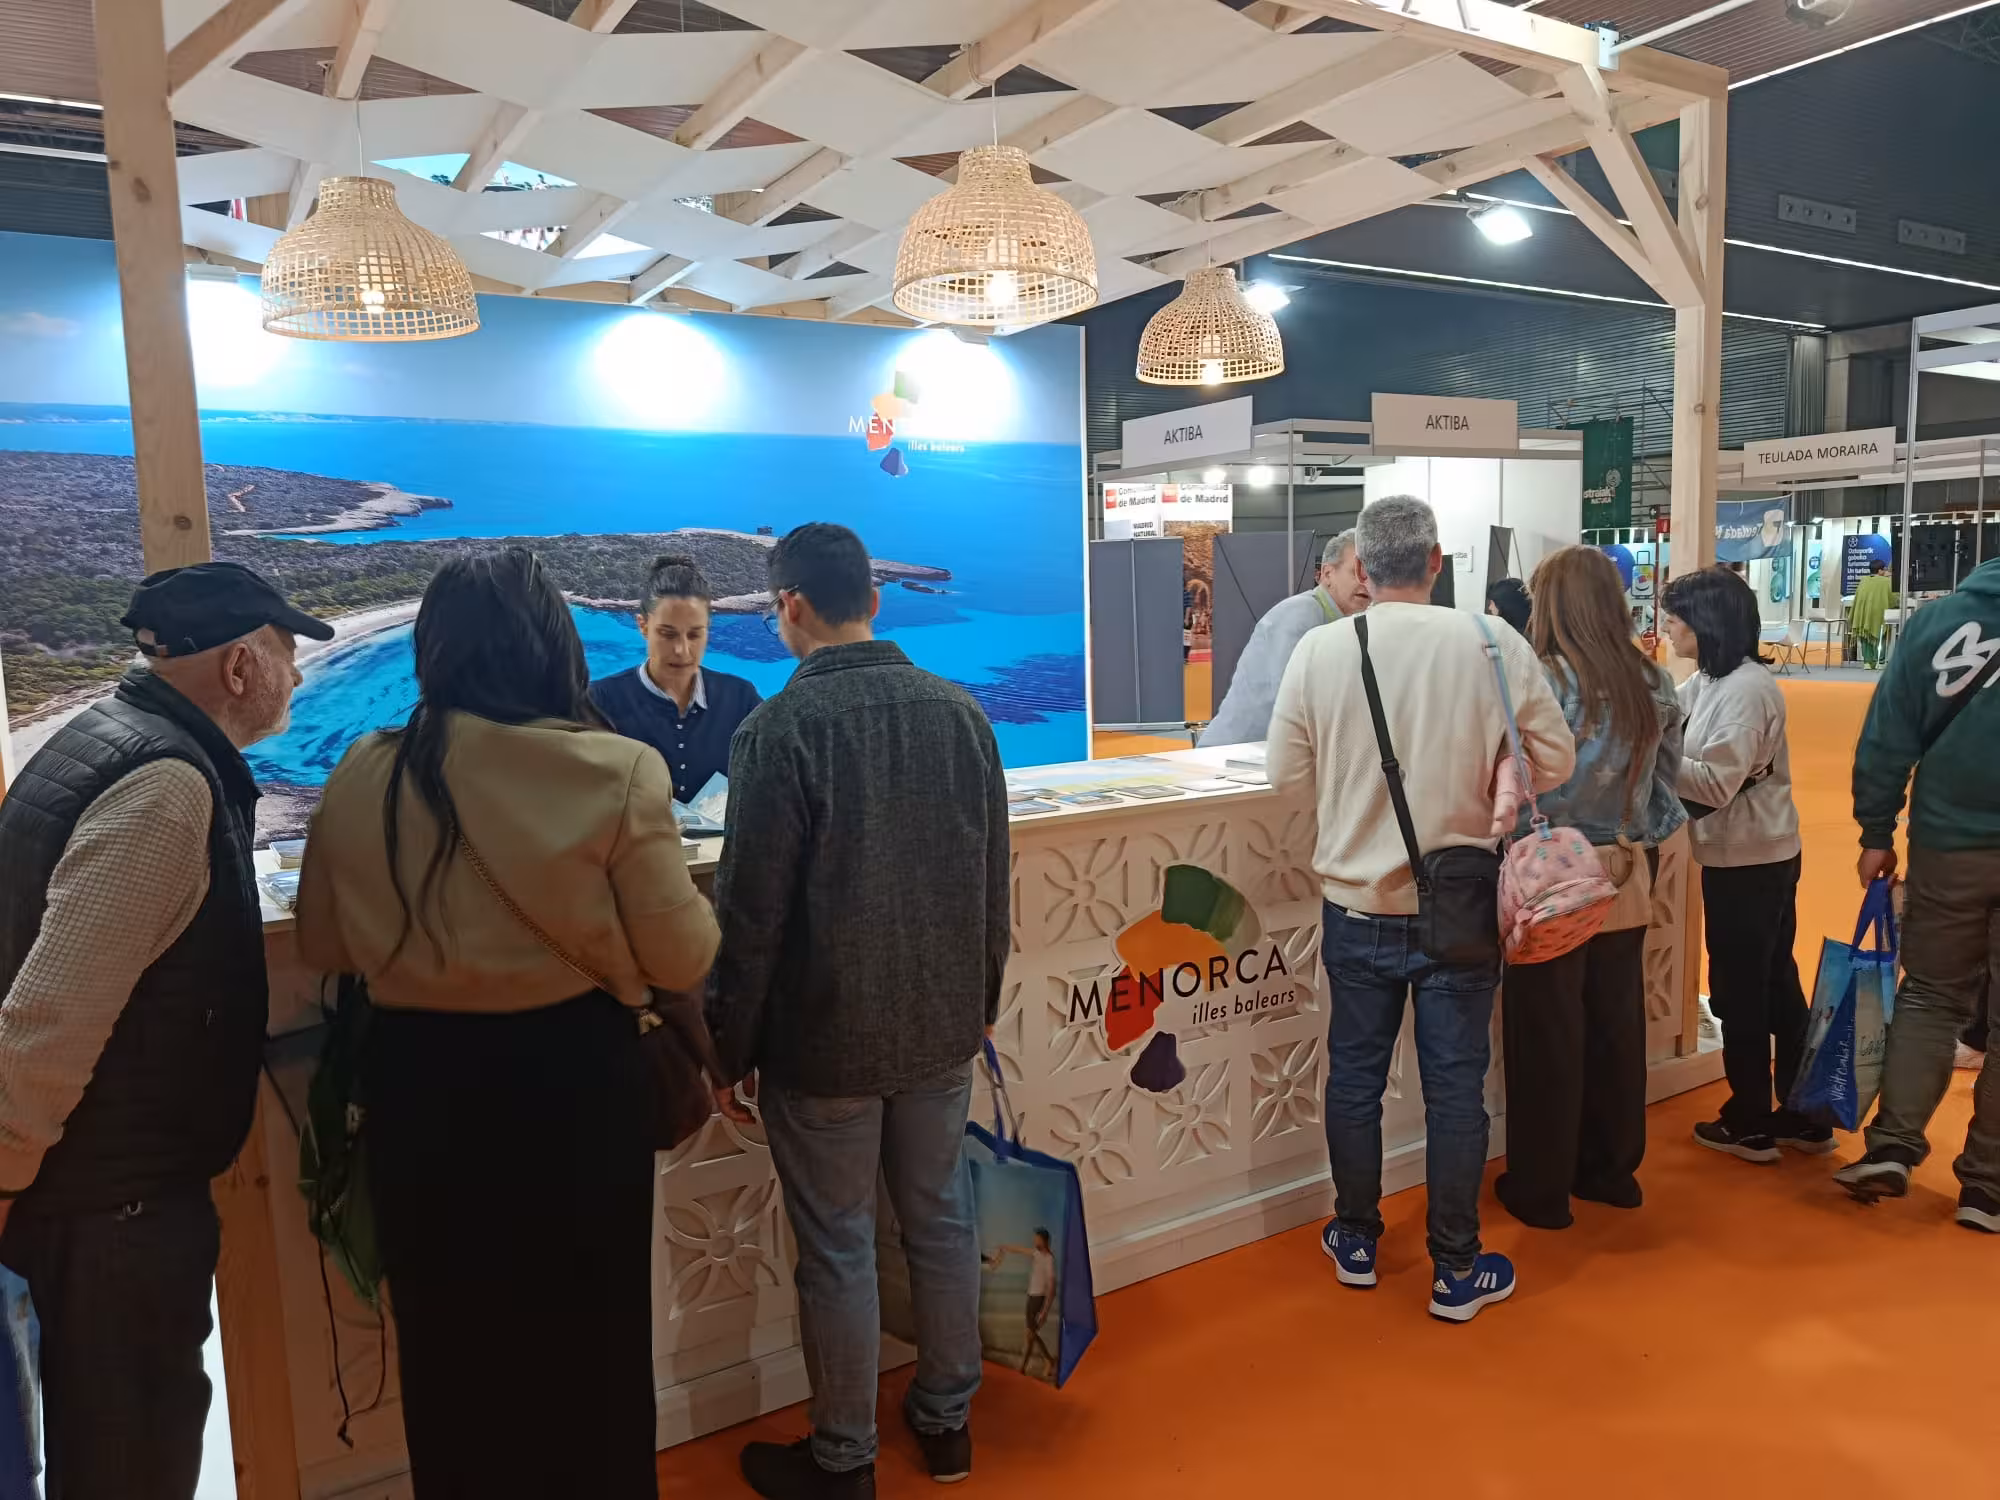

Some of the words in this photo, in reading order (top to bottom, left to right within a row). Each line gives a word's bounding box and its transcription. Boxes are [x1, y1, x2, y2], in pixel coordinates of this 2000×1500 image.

[1425, 414, 1470, 431] AKTIBA
[1163, 424, 1204, 445] AKTIBA
[1758, 449, 1813, 464] TEULADA
[1816, 442, 1879, 460] MORAIRA
[1129, 494, 1156, 505] Madrid
[1180, 495, 1193, 503] de
[1195, 494, 1229, 503] Madrid
[1069, 944, 1288, 1023] MENORCA
[1192, 1002, 1227, 1025] illes
[1234, 990, 1295, 1015] balears
